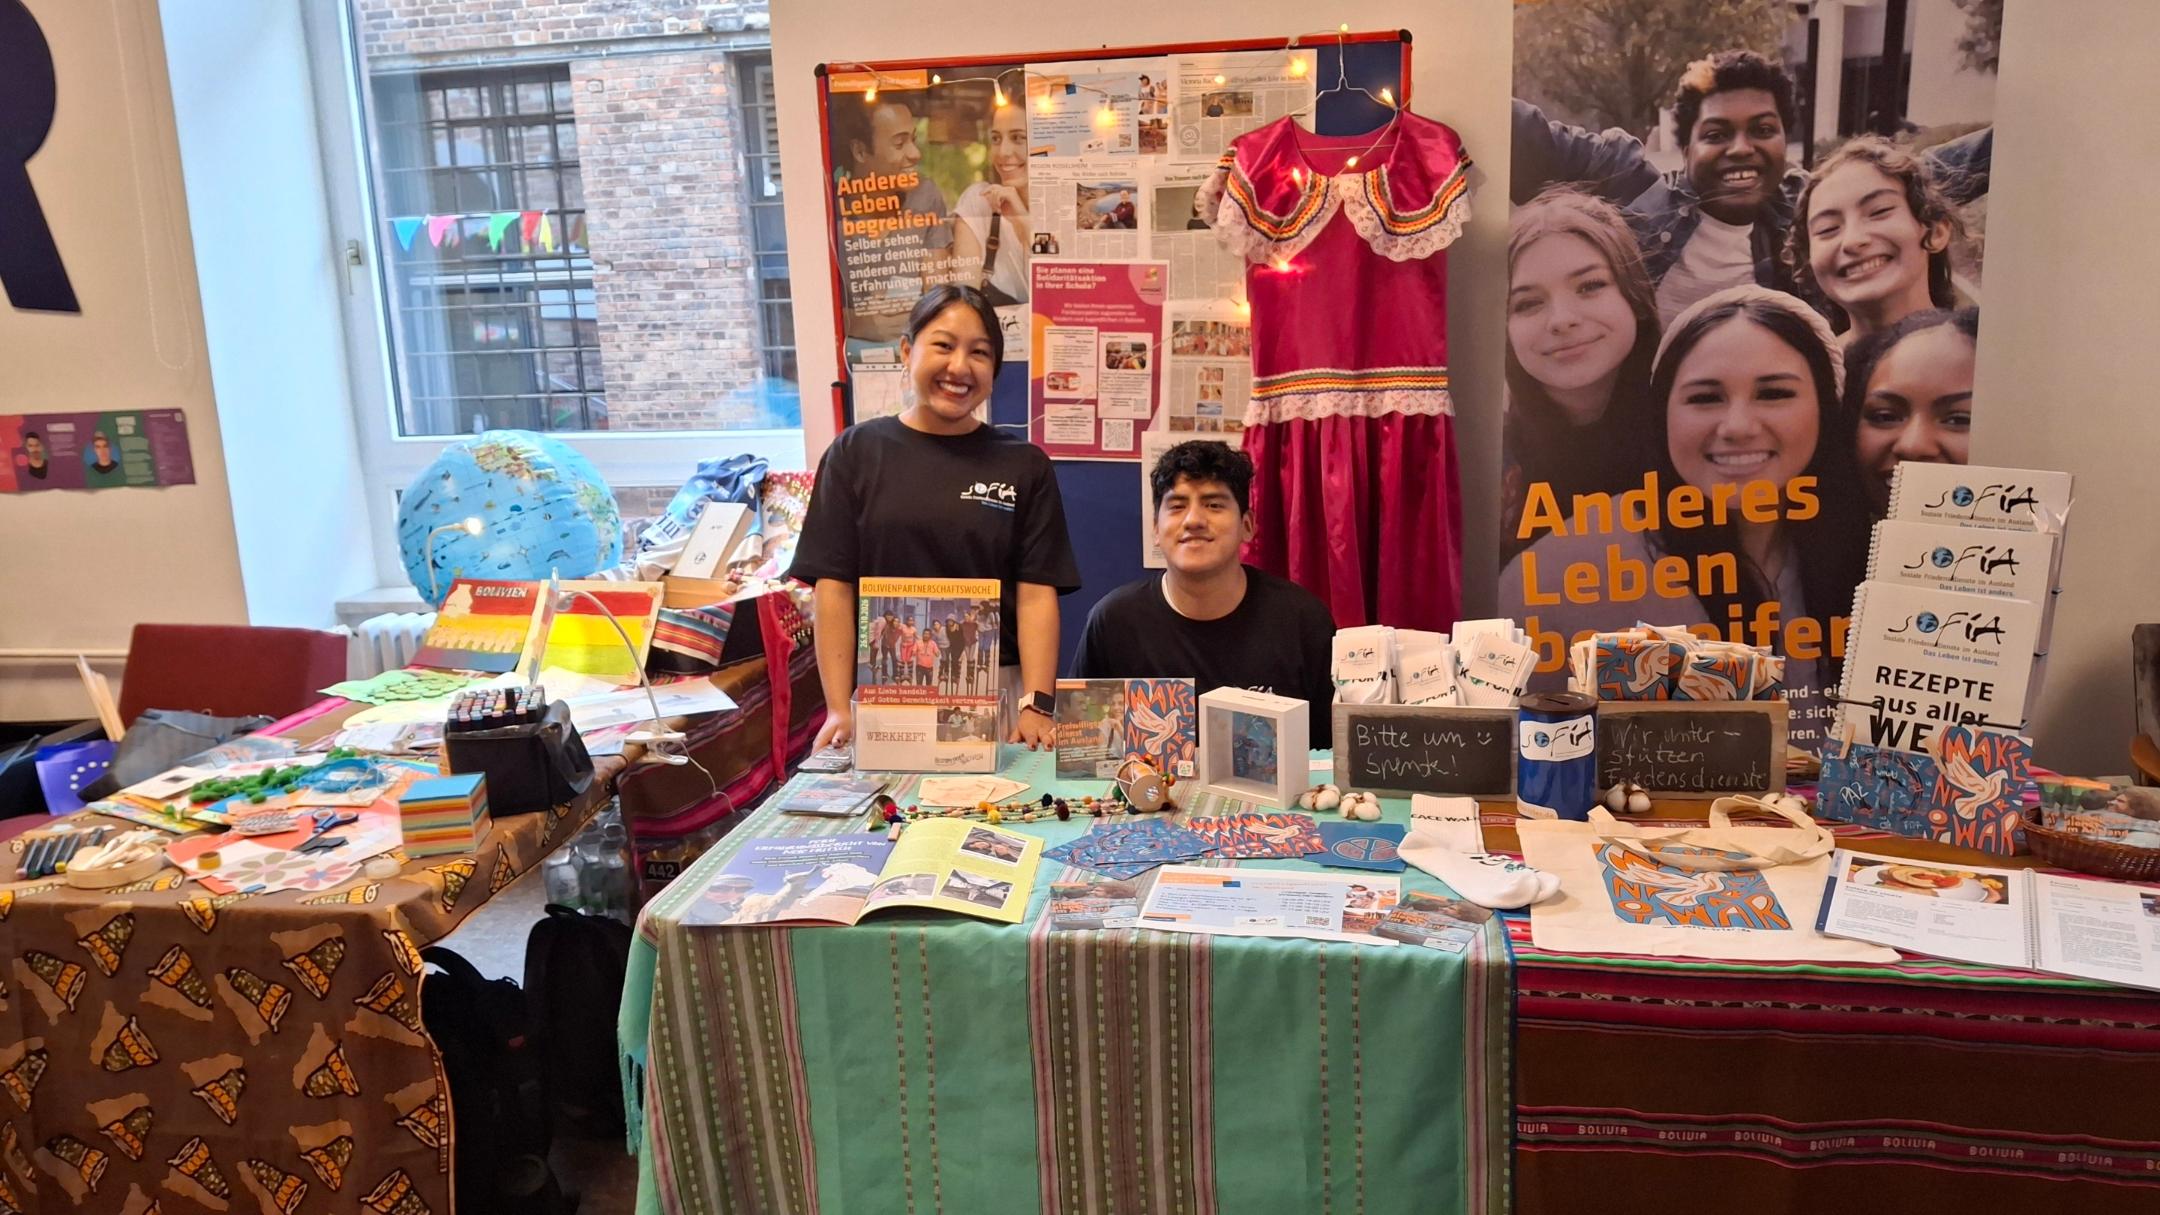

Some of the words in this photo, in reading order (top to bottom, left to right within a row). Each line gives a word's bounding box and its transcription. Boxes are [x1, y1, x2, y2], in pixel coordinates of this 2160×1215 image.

[837, 171, 920, 196] Anderes
[840, 195, 900, 216] Leben
[842, 209, 944, 237] begreifen.
[844, 237, 881, 251] Selber
[884, 233, 923, 248] sehen,
[847, 250, 882, 265] selber
[884, 246, 932, 262] denken,
[849, 265, 896, 279] anderen
[899, 260, 934, 277] Alltag
[1050, 267, 1077, 276] planen
[851, 276, 923, 293] Erfahrungen
[925, 270, 976, 285] machen.
[1516, 471, 1820, 539] Anderes
[1521, 544, 1738, 606] Leben
[475, 585, 530, 598] BOLIVIEN
[862, 583, 992, 595] BOLIVIENPARTNERSCHAFTSWOCHE
[1923, 648, 1936, 657] Das
[1938, 651, 1960, 660] Leben
[878, 687, 897, 695] Liebe
[1875, 665, 1994, 702] REZEPTE
[902, 697, 950, 705] Gerechtigkeit
[1872, 695, 1917, 715] aus
[1926, 701, 1989, 723] aller
[866, 731, 927, 743] WERKHEFT
[1356, 724, 1411, 747] Bitte
[1422, 730, 1466, 748] um
[1611, 722, 1653, 746] Wir
[1609, 745, 1705, 766] stützen
[1953, 811, 2018, 857] WAR
[648, 863, 676, 878] 442
[1577, 1124, 1628, 1136] BOLIVIA
[1658, 1131, 1708, 1142] BOLIVIA
[1734, 1131, 1783, 1146] BOLIVIA
[1810, 1136, 1856, 1152] BOLIVIA
[1882, 1136, 1937, 1151] BOLIVIA
[1969, 1145, 2025, 1160] BOLIVIA
[2057, 1152, 2114, 1168] BOLIVIA
